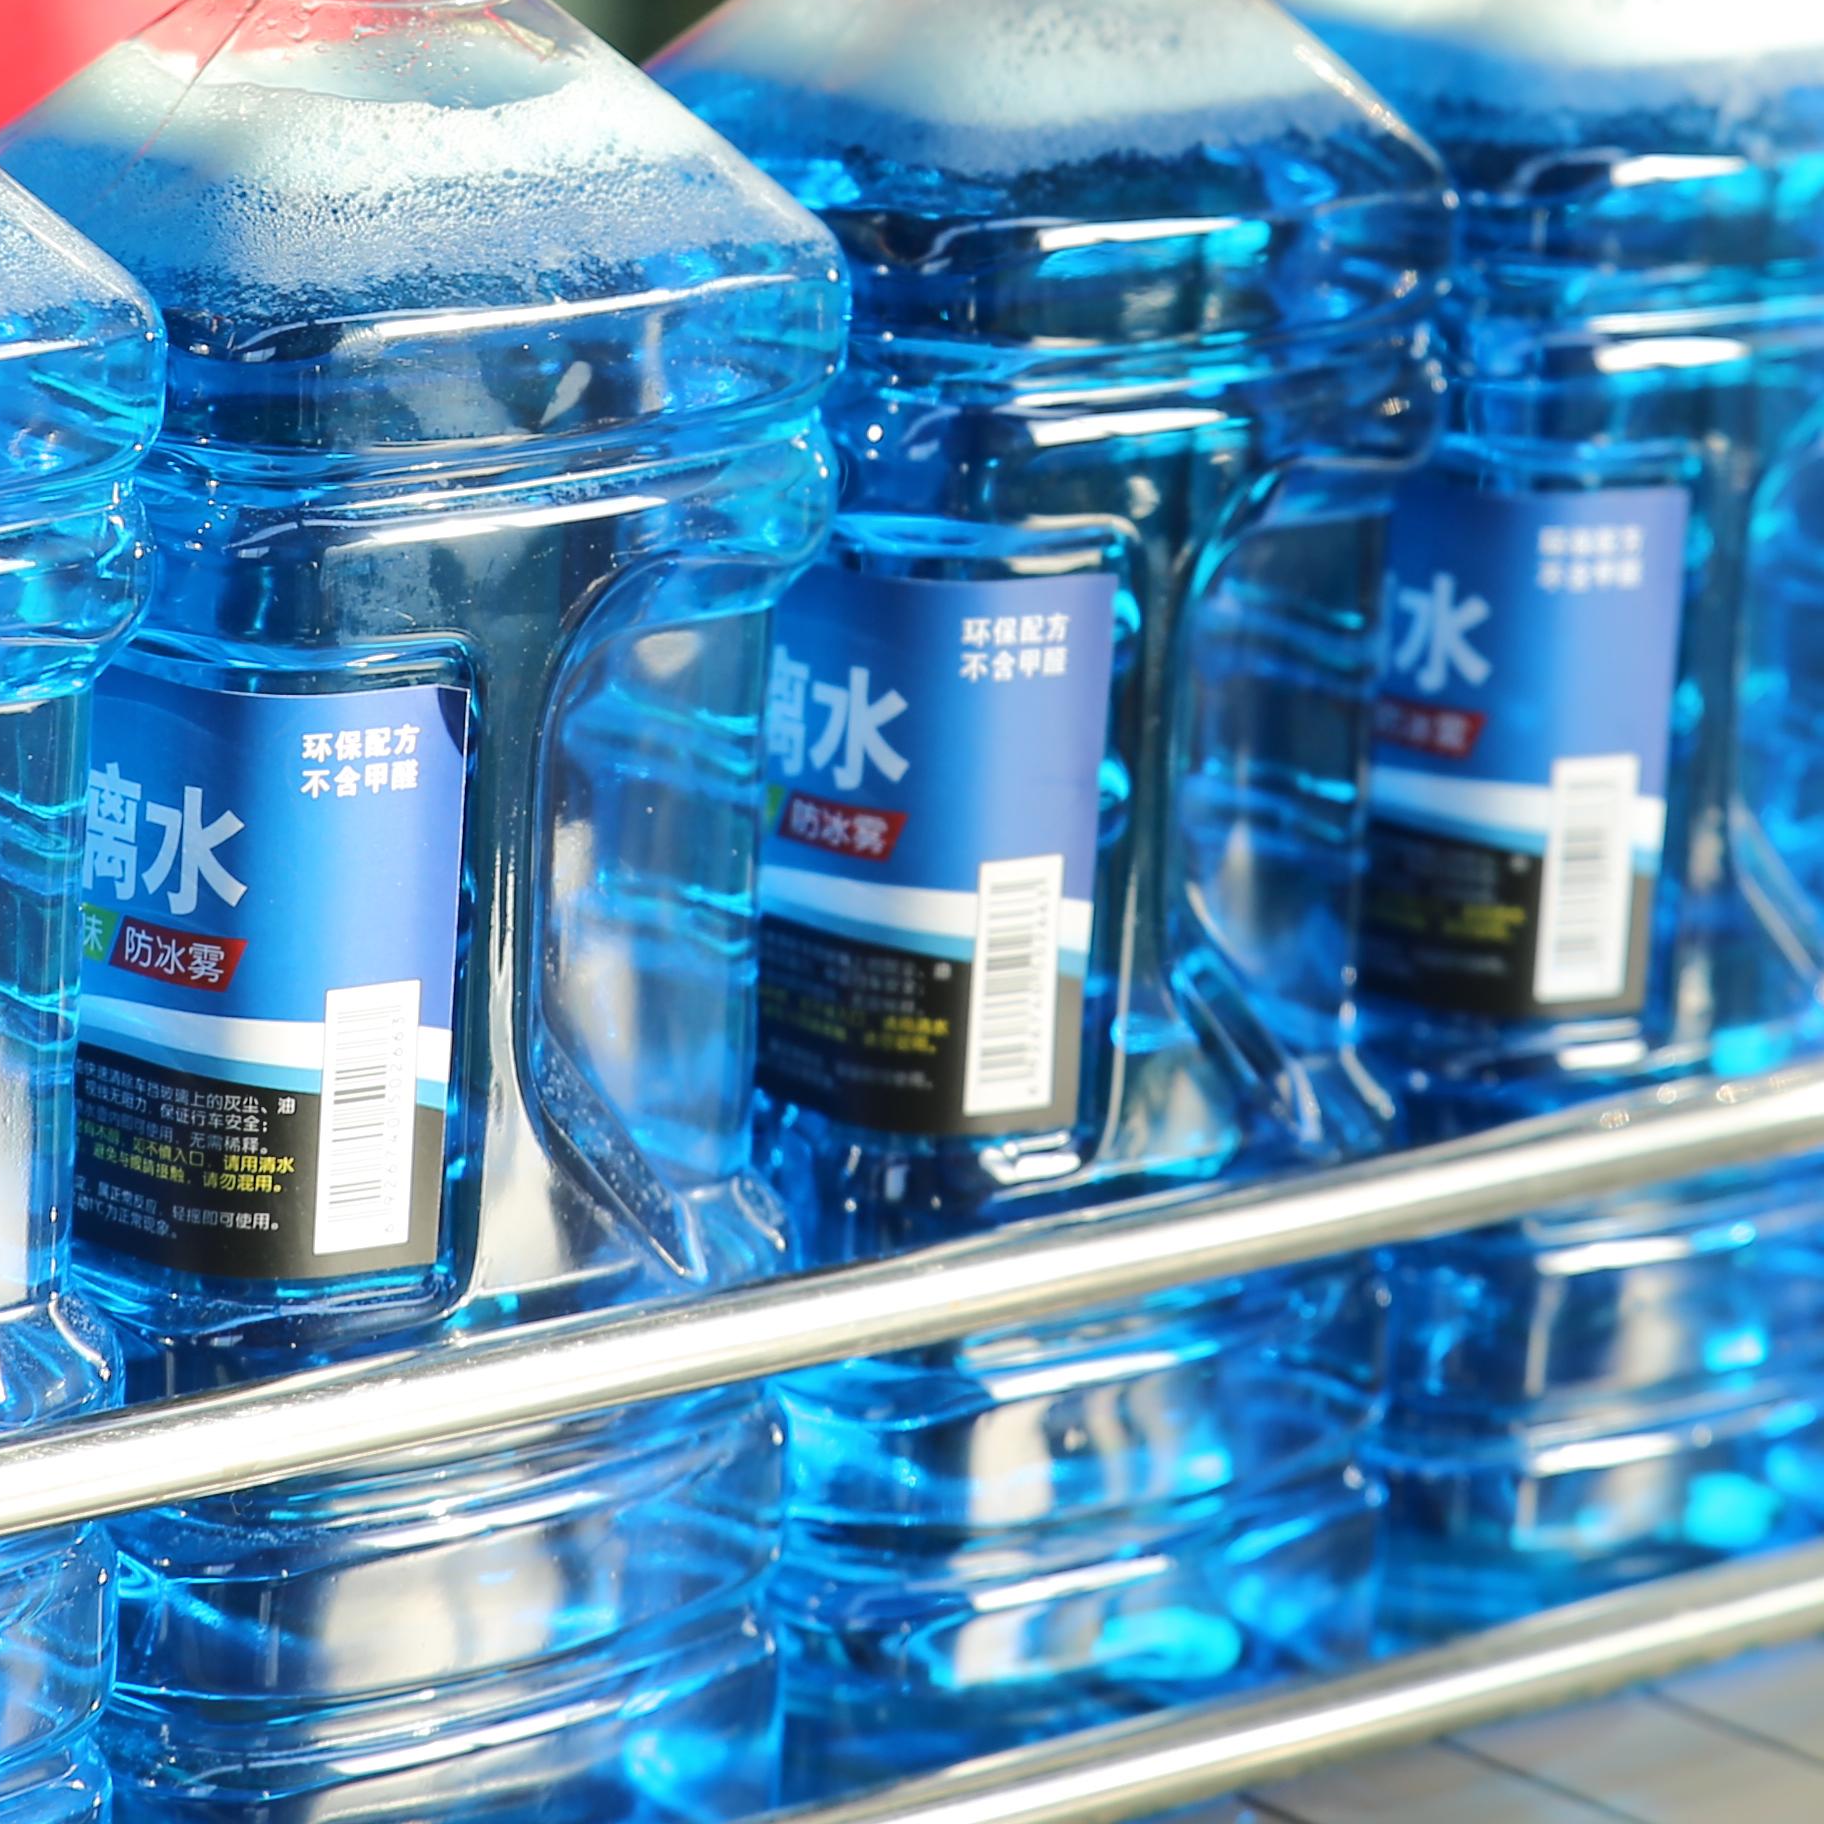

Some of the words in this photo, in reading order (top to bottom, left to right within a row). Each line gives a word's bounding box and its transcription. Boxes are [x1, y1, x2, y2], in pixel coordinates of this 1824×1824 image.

[961, 613, 1069, 649] 环保配方
[1381, 571, 1491, 692] 水
[960, 647, 1068, 683] 不含甲醛
[302, 723, 420, 763] 环保配方
[301, 759, 418, 799] 不含甲醛
[790, 799, 888, 856] 防冰雾
[125, 926, 225, 983] 防冰雾
